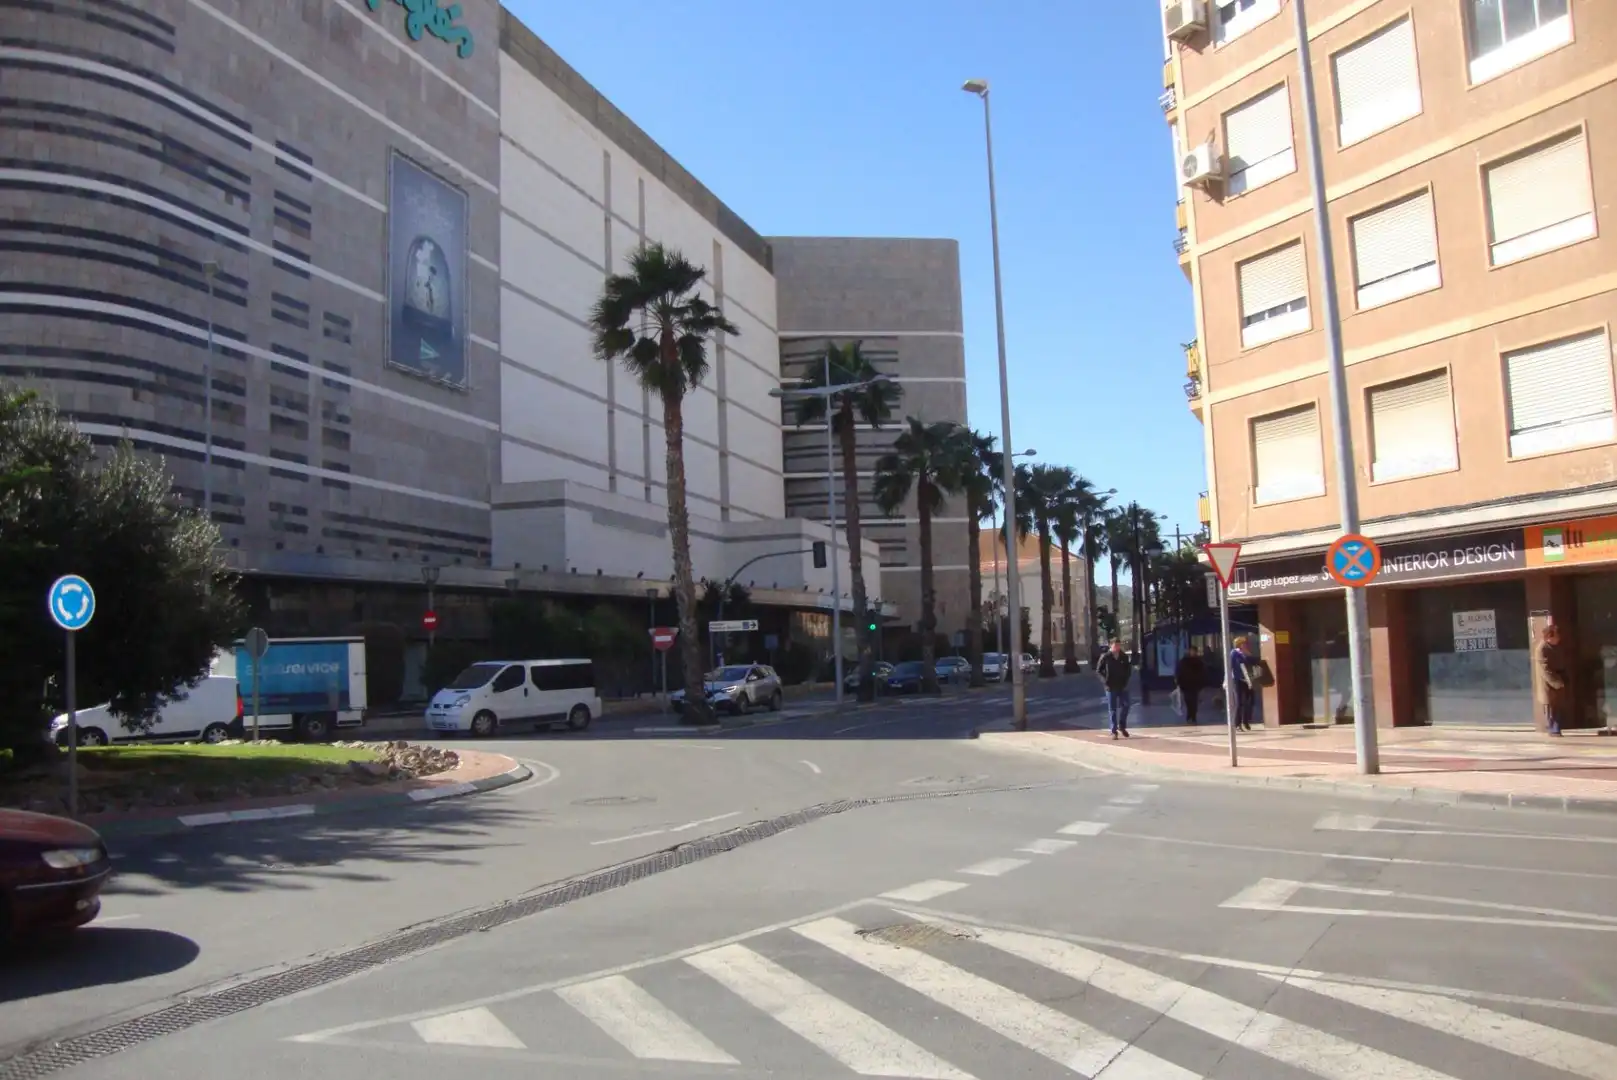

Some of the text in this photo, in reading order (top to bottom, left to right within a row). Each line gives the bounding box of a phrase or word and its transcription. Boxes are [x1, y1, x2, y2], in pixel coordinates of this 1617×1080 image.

[1383, 550, 1449, 575] INTERIOR
[1453, 543, 1516, 566] DESIGN
[1249, 577, 1272, 589] Jorge
[1273, 575, 1299, 587] Lopez
